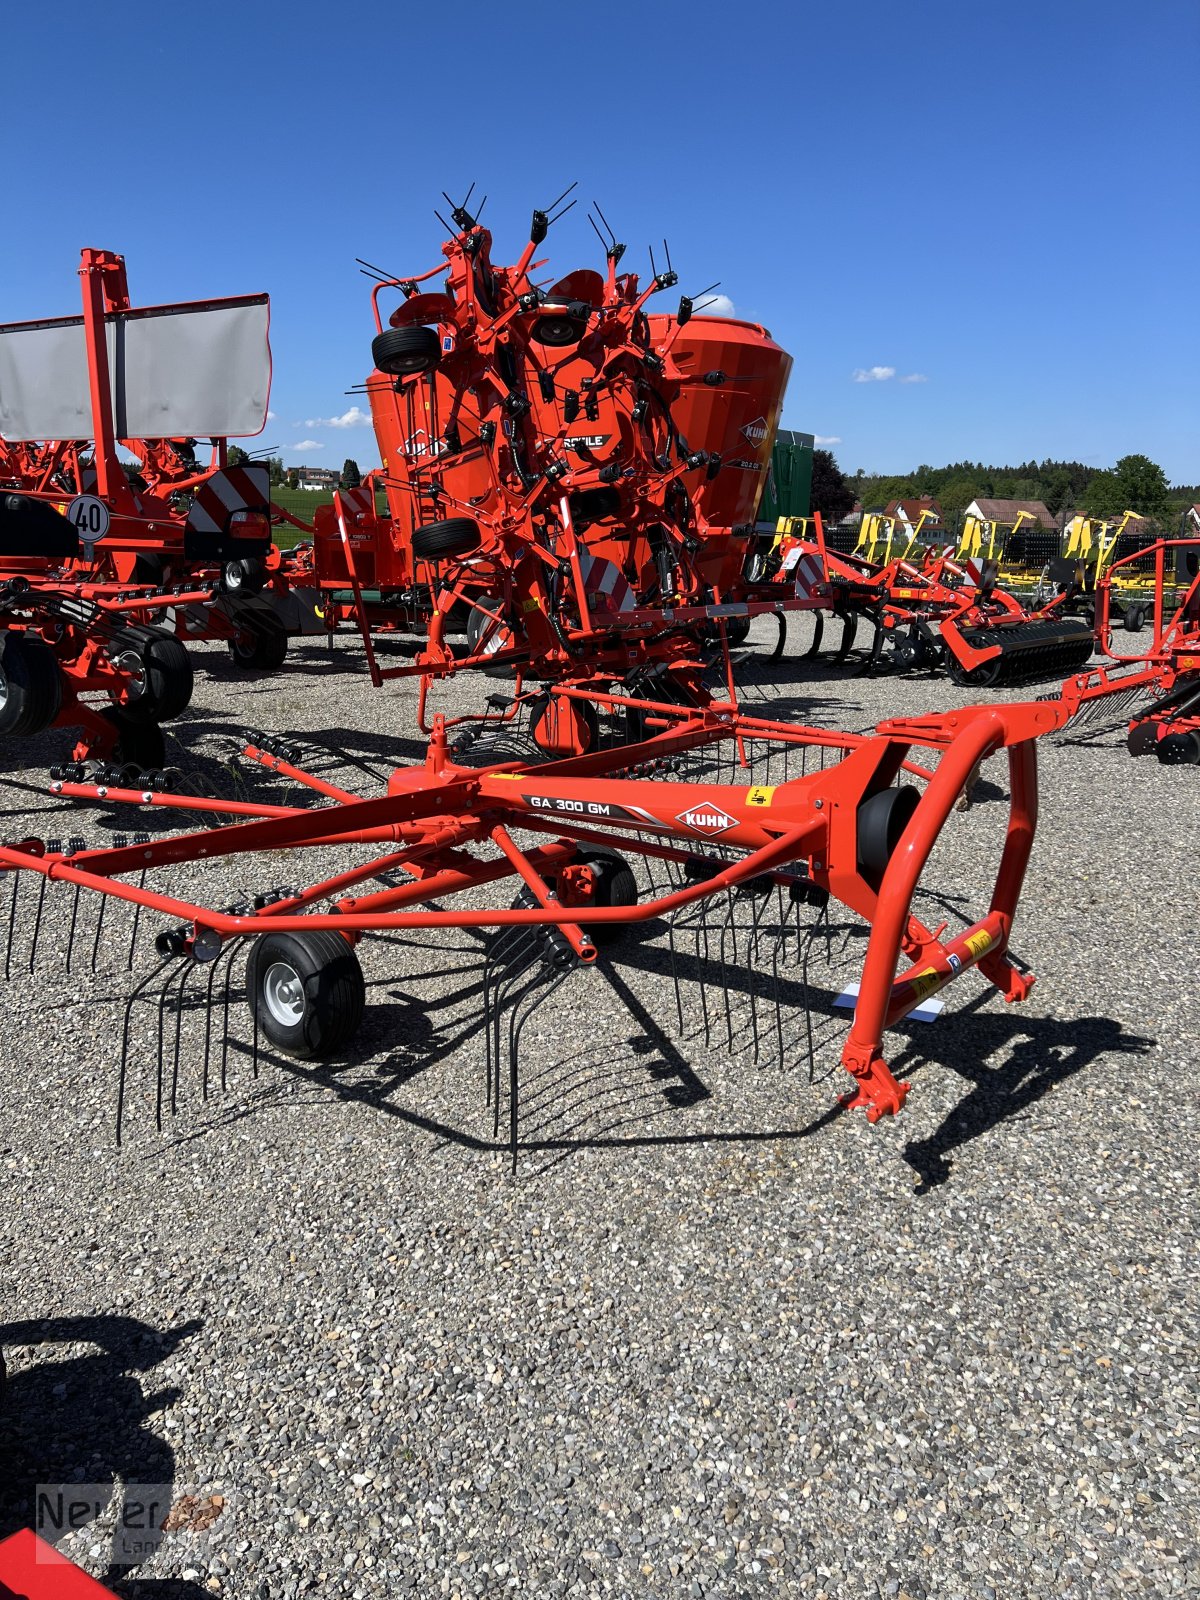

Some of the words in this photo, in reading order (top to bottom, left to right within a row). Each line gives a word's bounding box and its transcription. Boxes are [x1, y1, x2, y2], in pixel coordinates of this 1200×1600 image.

[745, 426, 767, 440] KUHN
[75, 503, 100, 533] 40
[531, 797, 552, 809] GA
[556, 799, 584, 812] 300
[588, 803, 611, 816] GM
[686, 813, 728, 828] KUHN
